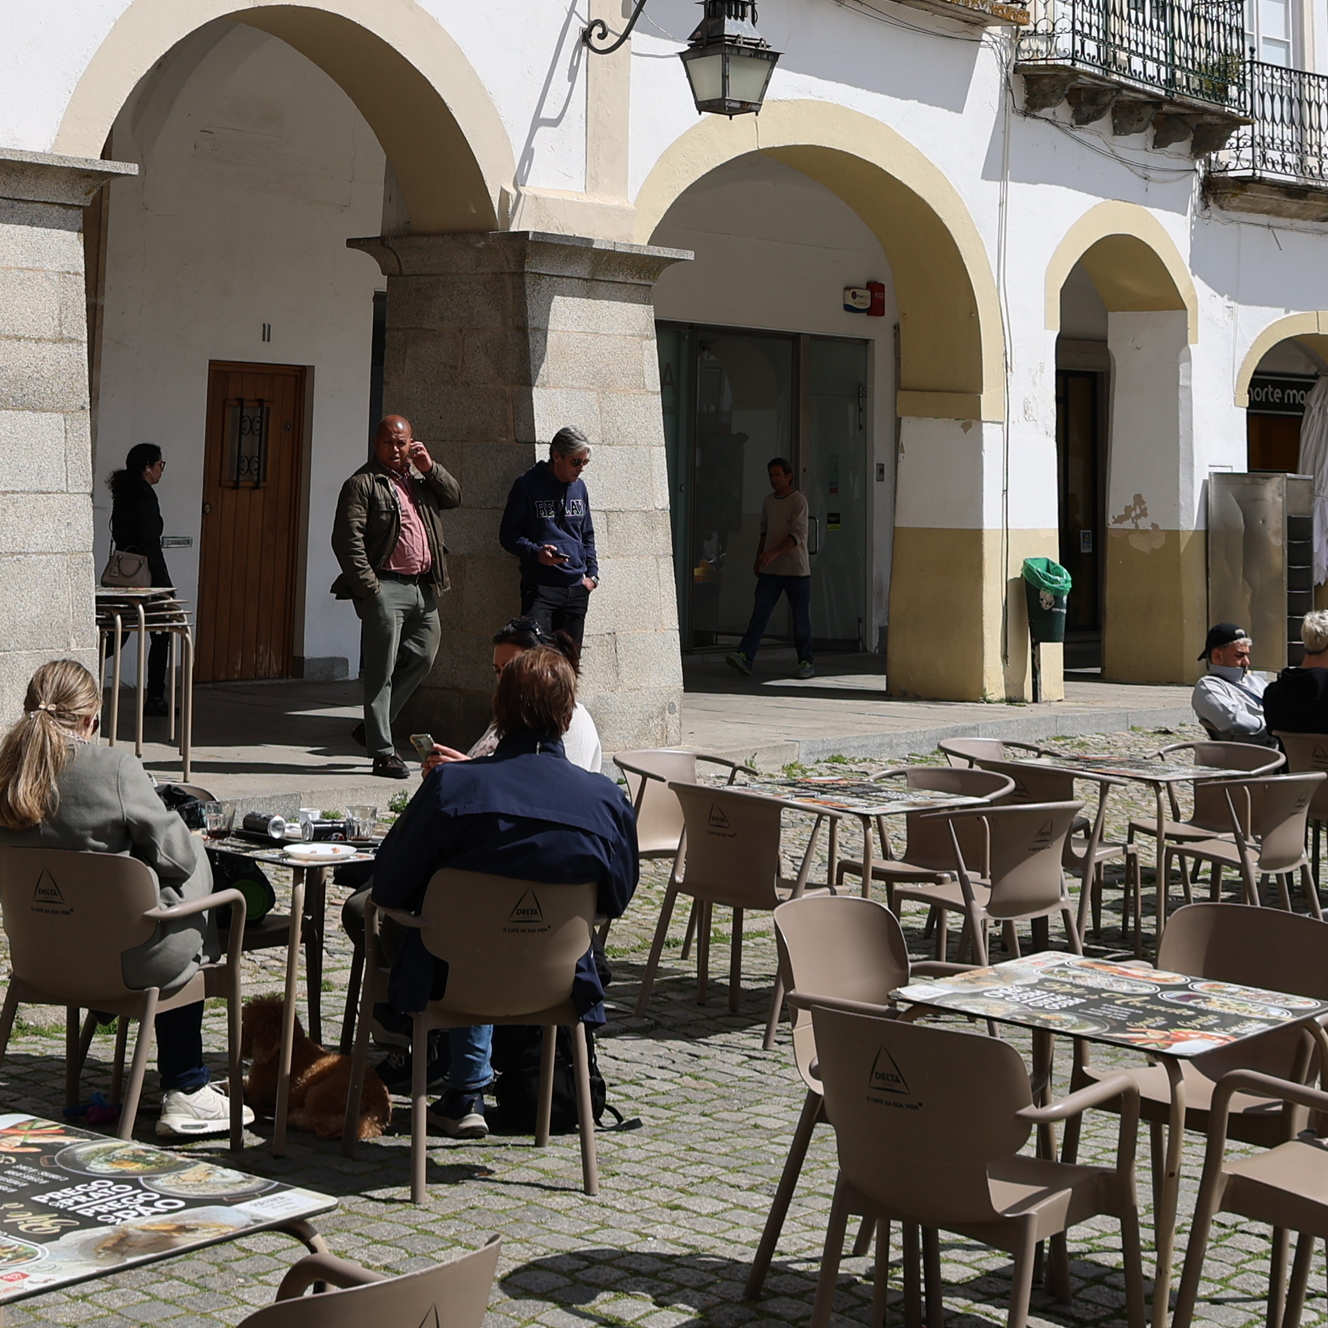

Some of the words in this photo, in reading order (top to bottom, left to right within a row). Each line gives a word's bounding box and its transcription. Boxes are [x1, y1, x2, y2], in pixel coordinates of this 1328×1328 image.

[29, 1179, 114, 1205] PREGO
[59, 1184, 133, 1205] PRATO
[74, 1189, 161, 1217] PREGO
[108, 1195, 185, 1222] PÃO
